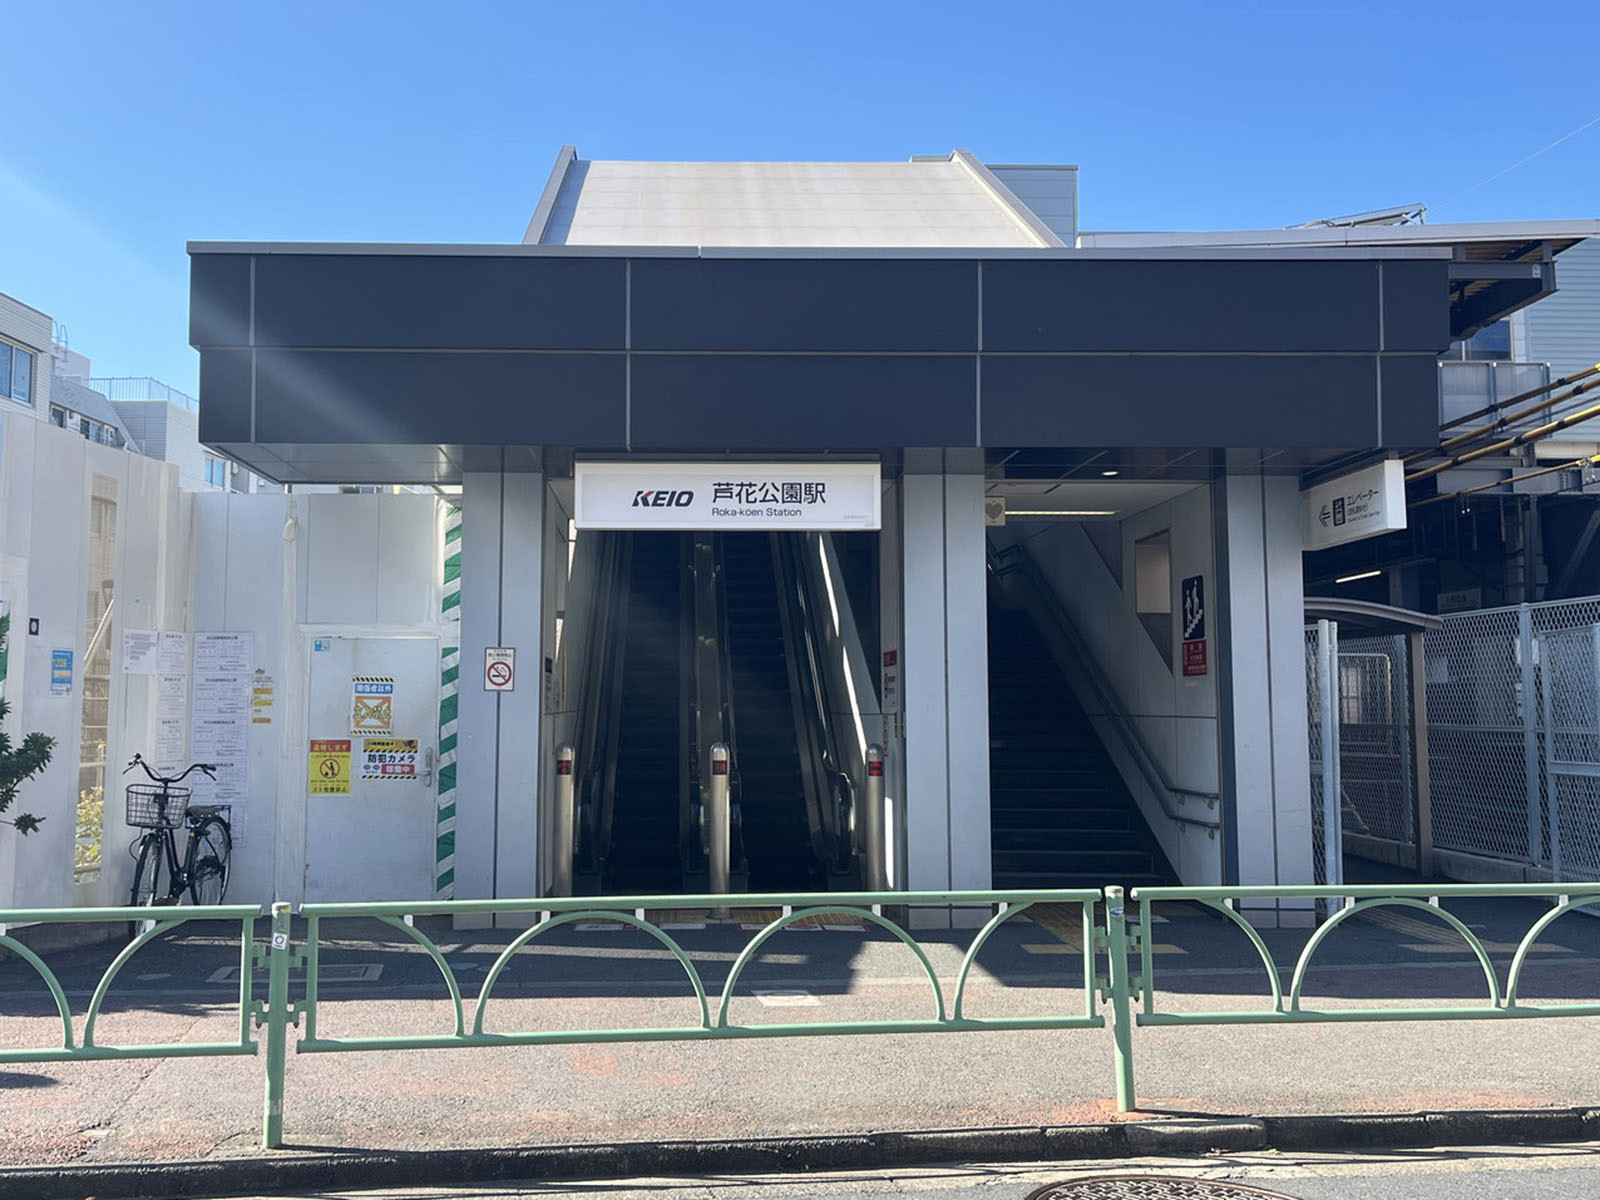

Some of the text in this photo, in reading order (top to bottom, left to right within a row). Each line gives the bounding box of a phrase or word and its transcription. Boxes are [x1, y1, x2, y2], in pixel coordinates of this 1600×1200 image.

[632, 490, 694, 507] KEIO
[712, 482, 826, 505] 芦花公園駅
[1347, 490, 1379, 505] エレベーター
[766, 507, 802, 517] Station
[368, 754, 416, 763] 防犯カメラ
